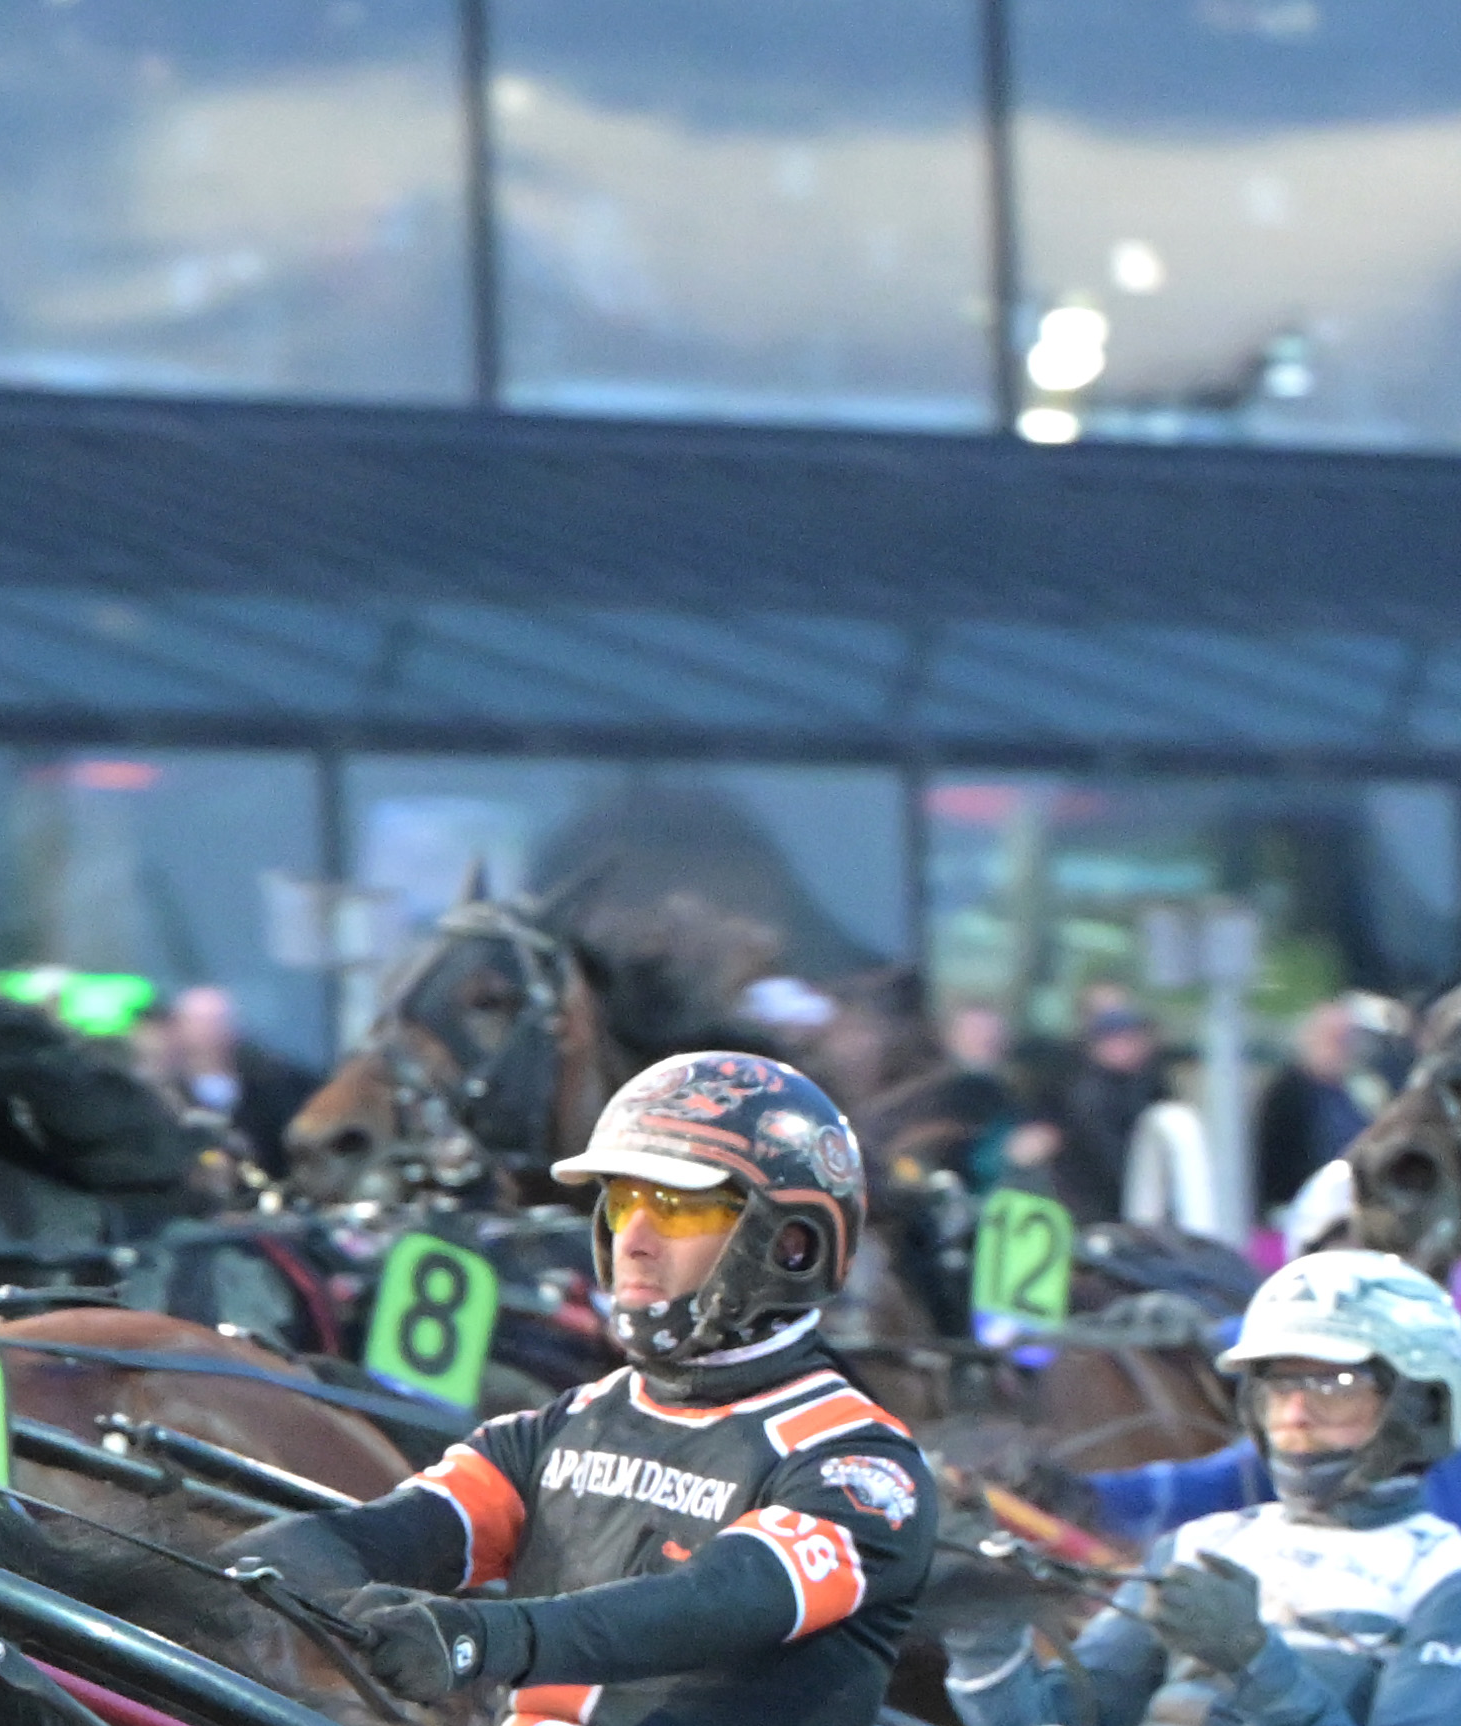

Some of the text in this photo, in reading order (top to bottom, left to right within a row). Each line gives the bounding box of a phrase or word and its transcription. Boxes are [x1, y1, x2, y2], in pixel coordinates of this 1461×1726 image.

[399, 1253, 470, 1377] 8
[984, 1206, 1063, 1317] 12
[635, 1460, 744, 1523] DESIGN
